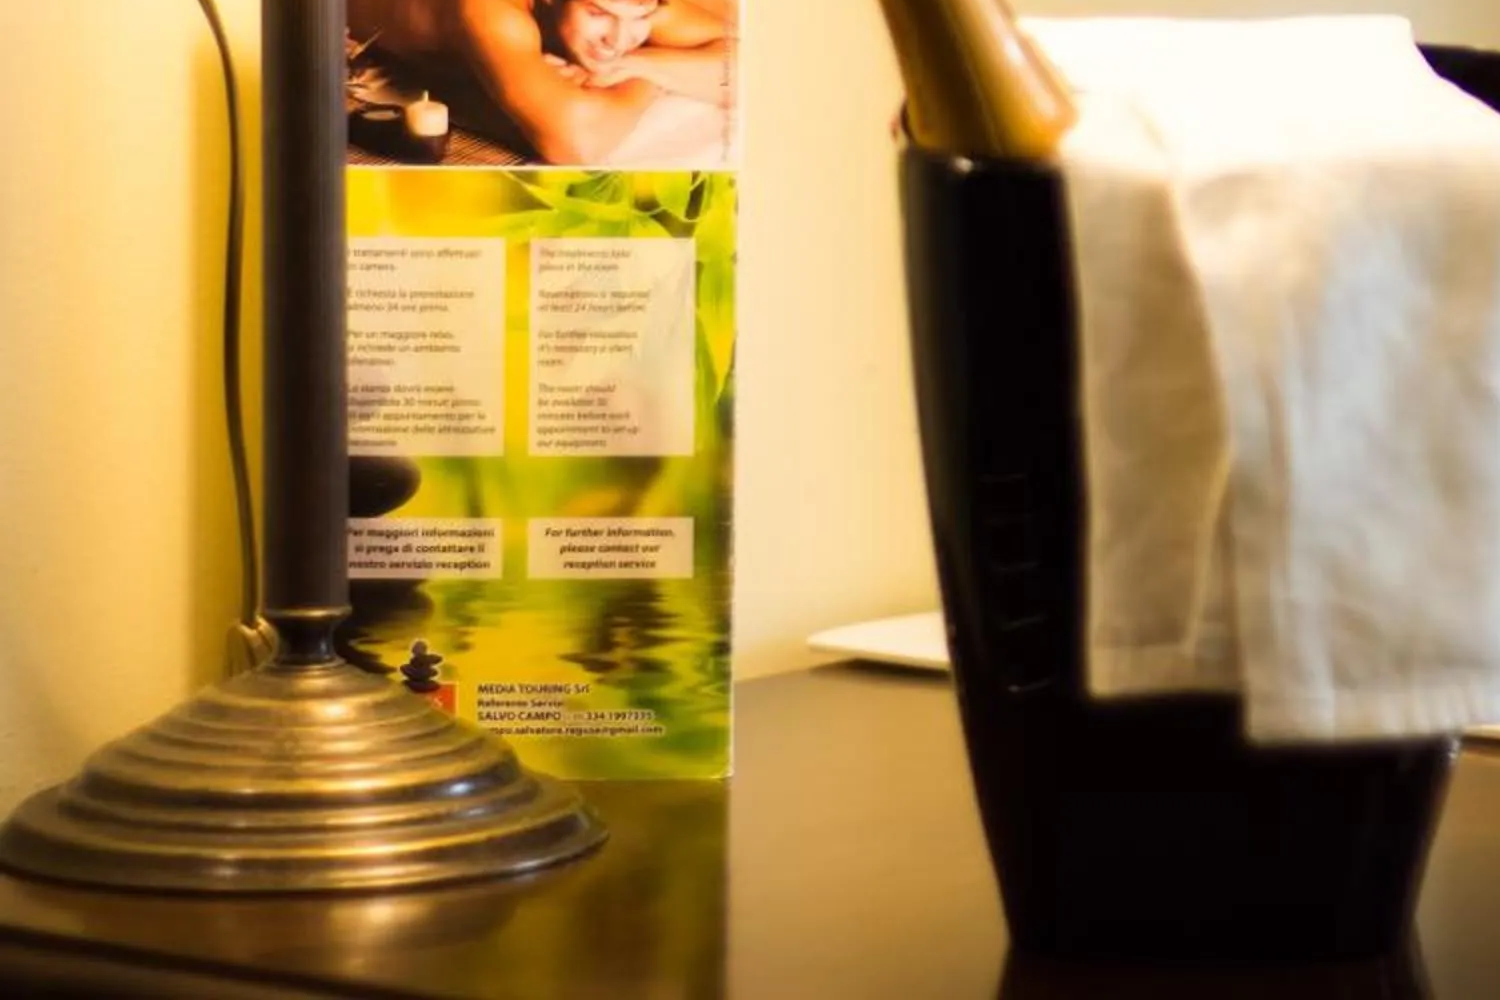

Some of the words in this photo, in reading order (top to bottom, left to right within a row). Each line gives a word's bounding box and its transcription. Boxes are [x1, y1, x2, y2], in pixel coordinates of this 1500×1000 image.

[366, 528, 419, 541] maggiori
[421, 528, 495, 538] informazioni
[545, 527, 563, 538] For
[565, 527, 605, 538] further
[365, 545, 399, 556] prega
[401, 543, 413, 553] di
[559, 542, 596, 556] please
[598, 542, 640, 553] contact
[389, 559, 434, 569] servizio
[435, 559, 491, 572] reception
[563, 558, 617, 572] reception
[618, 558, 657, 569] service
[477, 684, 516, 695] MEDIA
[518, 684, 571, 695] TOURING
[477, 711, 515, 722] SALVO
[517, 711, 562, 722] CAMPO
